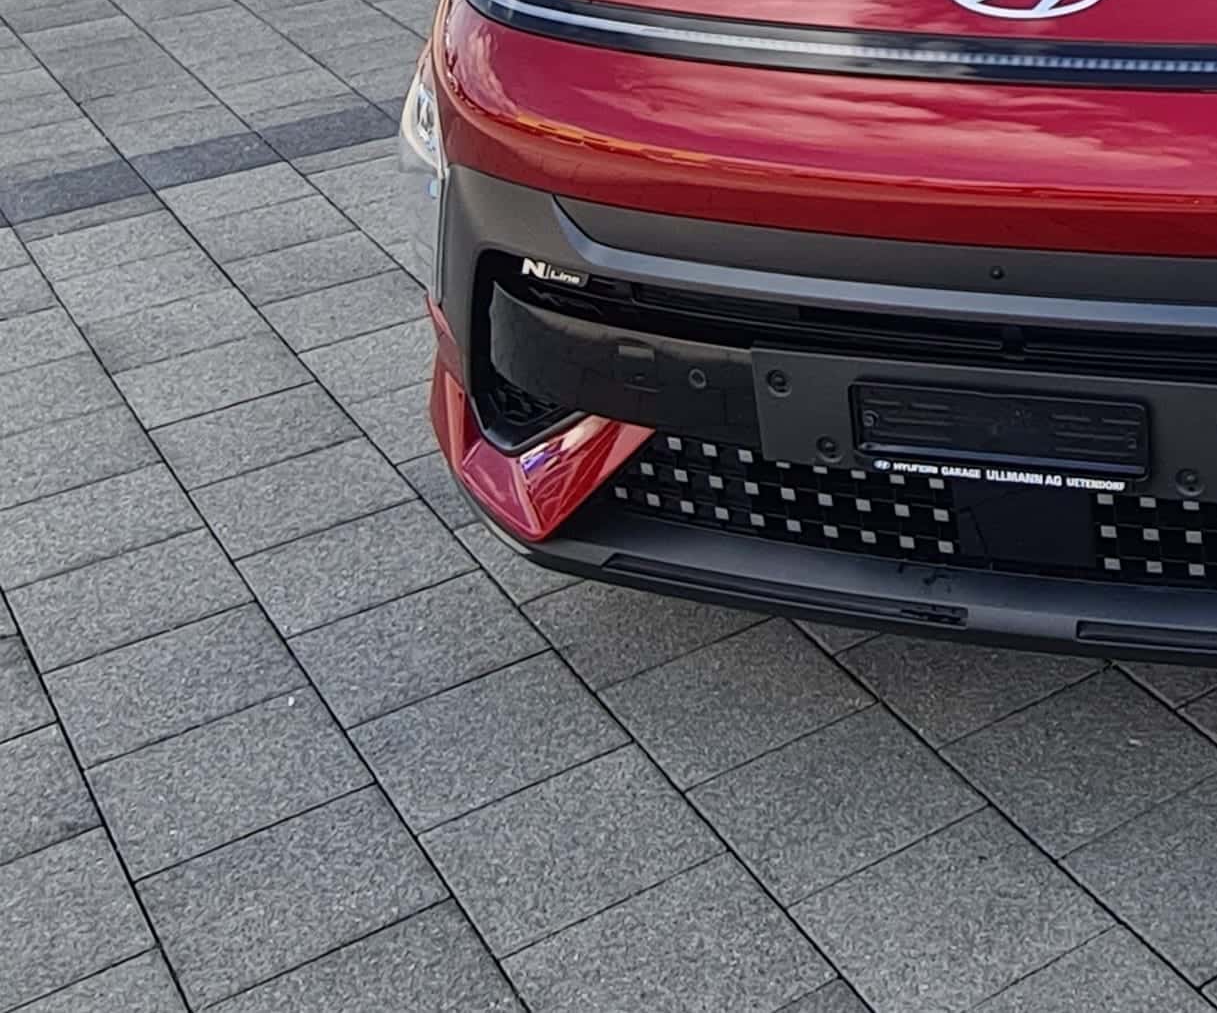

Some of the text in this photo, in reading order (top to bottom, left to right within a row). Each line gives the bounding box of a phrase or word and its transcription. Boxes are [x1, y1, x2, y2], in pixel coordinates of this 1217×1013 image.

[522, 257, 581, 285] N Line
[941, 465, 982, 479] GARAGE
[986, 469, 1043, 485] ULLMANN
[1044, 475, 1063, 487] AG
